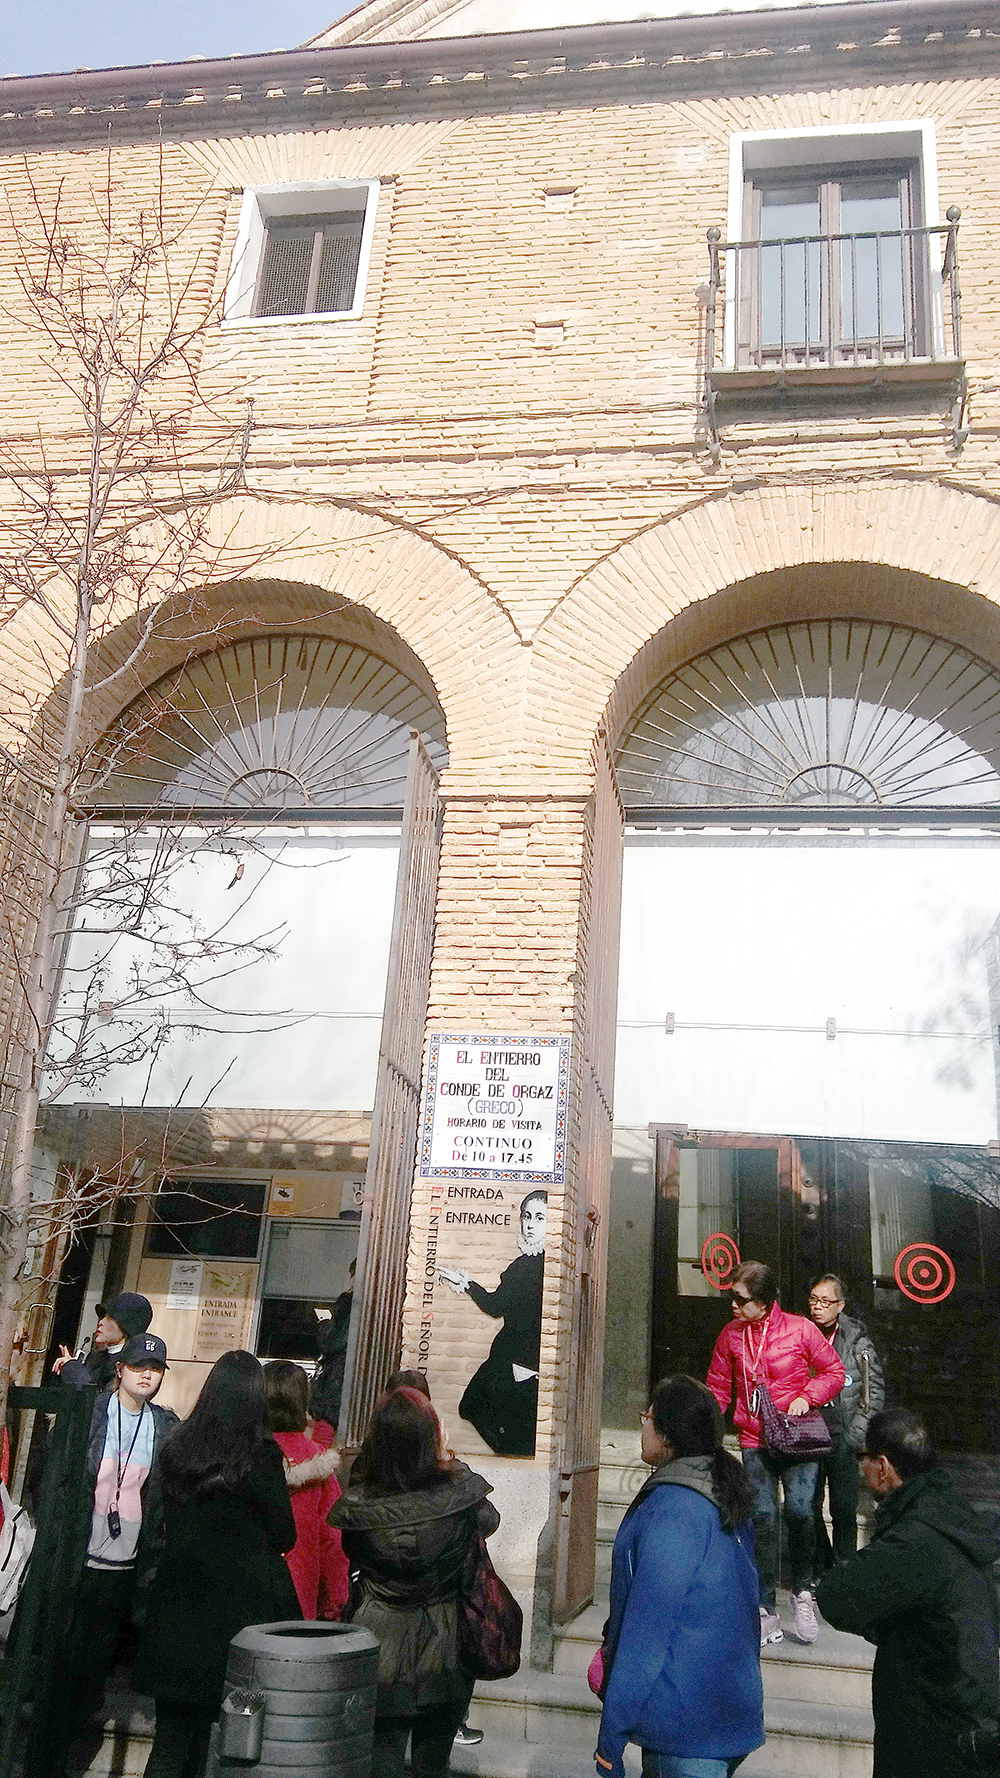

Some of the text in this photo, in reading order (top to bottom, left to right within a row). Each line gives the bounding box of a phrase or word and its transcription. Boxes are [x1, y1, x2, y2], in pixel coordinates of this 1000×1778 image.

[456, 1050, 541, 1066] EL ENTIERRO
[485, 1067, 510, 1081] DEL
[440, 1082, 553, 1099] CONDE DE ORGAZ
[467, 1097, 524, 1117] (GRECO)
[447, 1117, 543, 1131] HORARIO DE VISITA
[453, 1135, 533, 1150] CONTINUO
[452, 1150, 533, 1165] De 10 a 17,45
[430, 1186, 444, 1202] EL
[447, 1186, 504, 1200] ENTRADA
[445, 1211, 511, 1226] ENTRANCE
[424, 1206, 443, 1277] ENTIERRO
[422, 1281, 434, 1308] DEL
[204, 1299, 237, 1309] ENTRADA
[201, 1308, 237, 1318] ENTRANCE
[418, 1312, 434, 1362] SEÑOR
